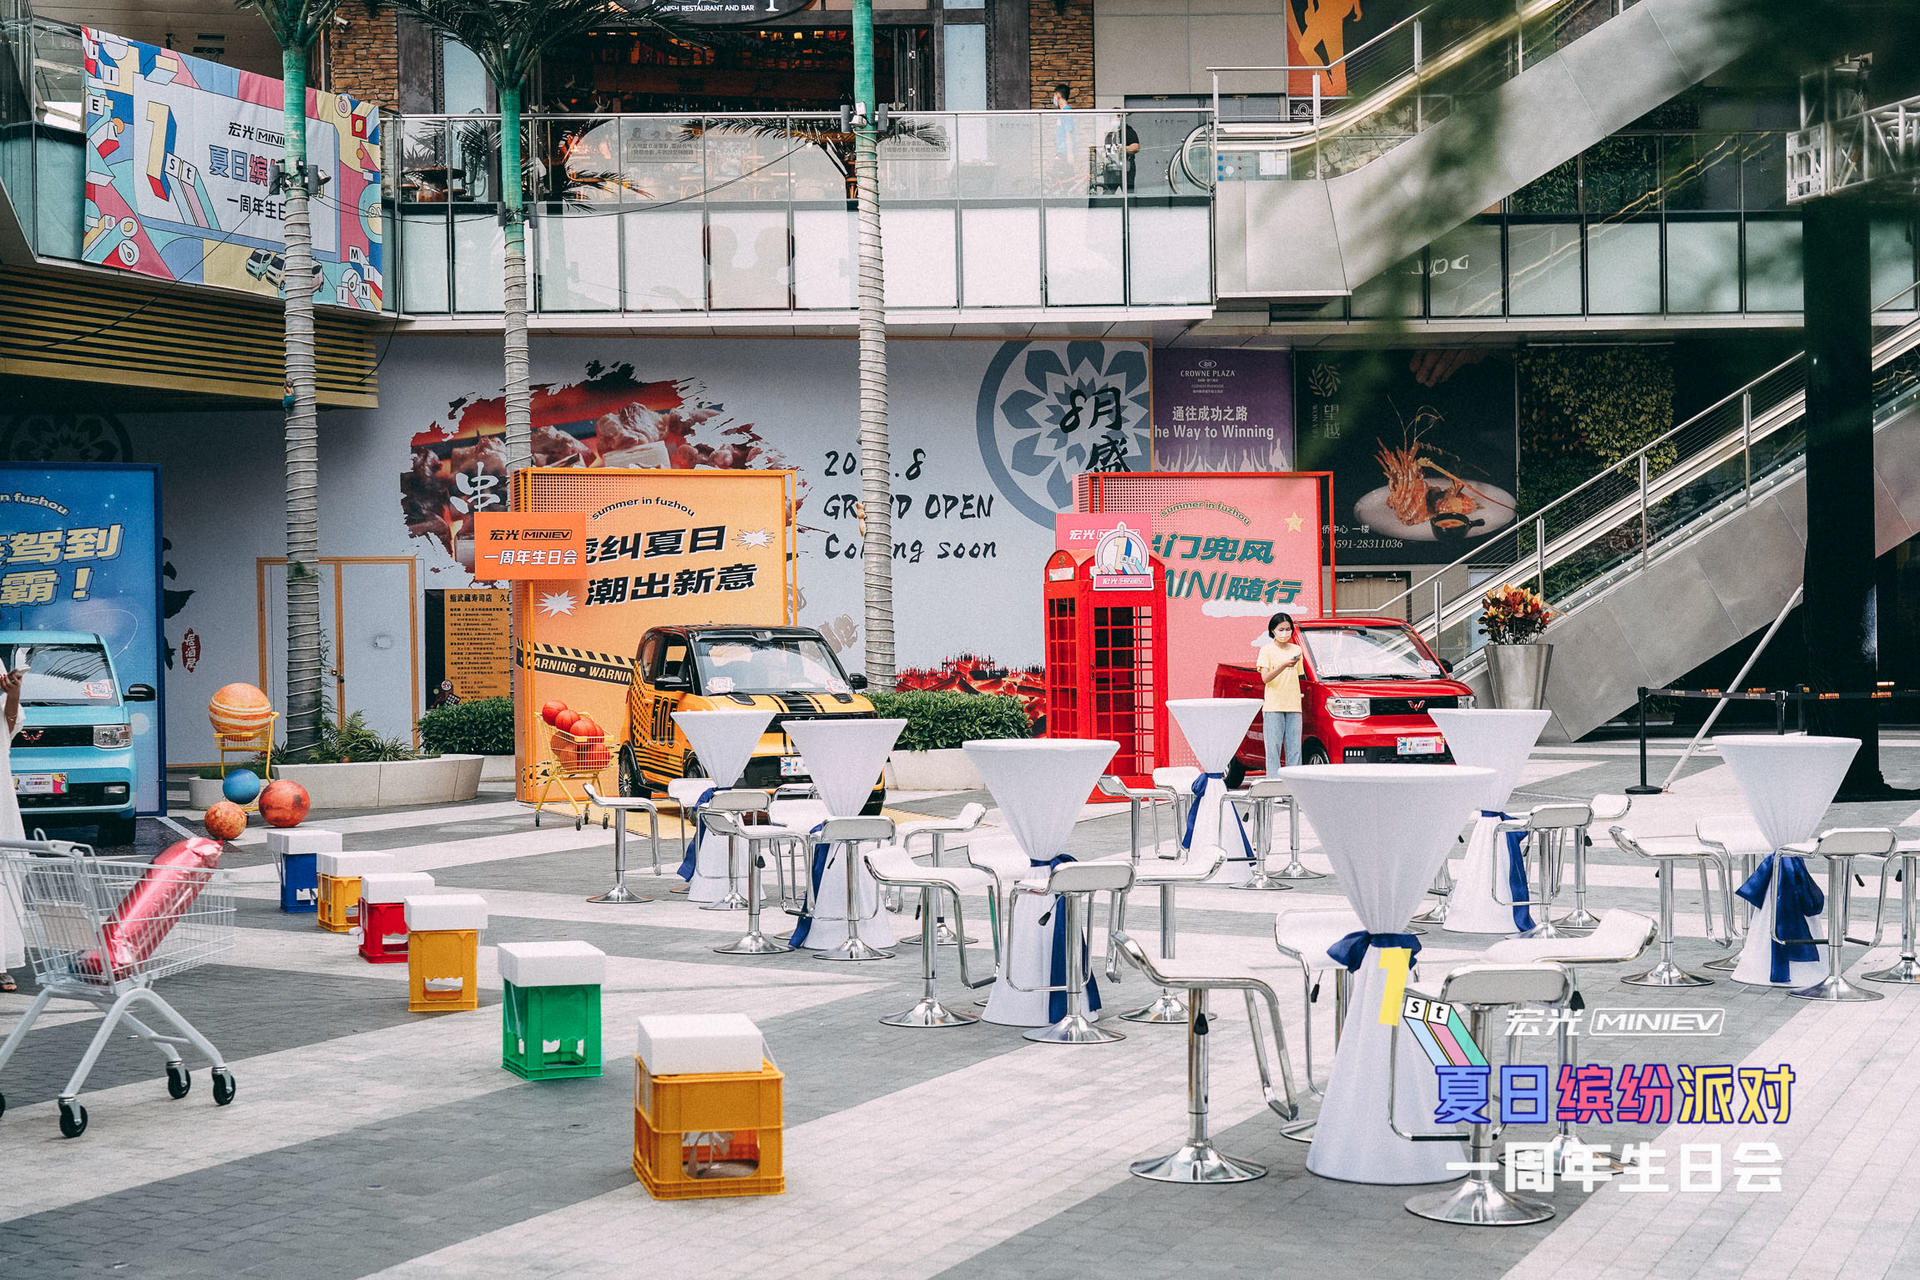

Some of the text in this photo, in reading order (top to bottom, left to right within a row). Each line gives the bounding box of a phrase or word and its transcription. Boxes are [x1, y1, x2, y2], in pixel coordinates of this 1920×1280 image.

[228, 122, 285, 146] 宏光 MINI
[208, 144, 276, 187] 夏日缤
[227, 194, 286, 221] 一周年生日
[1172, 406, 1248, 421] 通往成功之路
[1154, 424, 1274, 440] he Way to Winning
[824, 448, 926, 481] 20.8
[0, 492, 70, 517] n fuzhou
[592, 497, 695, 520] summer in fuzhou
[824, 494, 994, 520] GRD OPEN
[1161, 501, 1251, 526] summer in fuzhou
[0, 524, 124, 568] 驾到
[490, 529, 571, 541] 宏光 MINIEV
[1069, 530, 1096, 540] 宏光
[1333, 539, 1404, 549] 591-28311036
[484, 549, 578, 565] 一周年生日会
[825, 533, 997, 563] Cong soon
[585, 563, 758, 607] 潮出新意
[1165, 569, 1303, 604] INI随行
[589, 666, 634, 682] WARNIN
